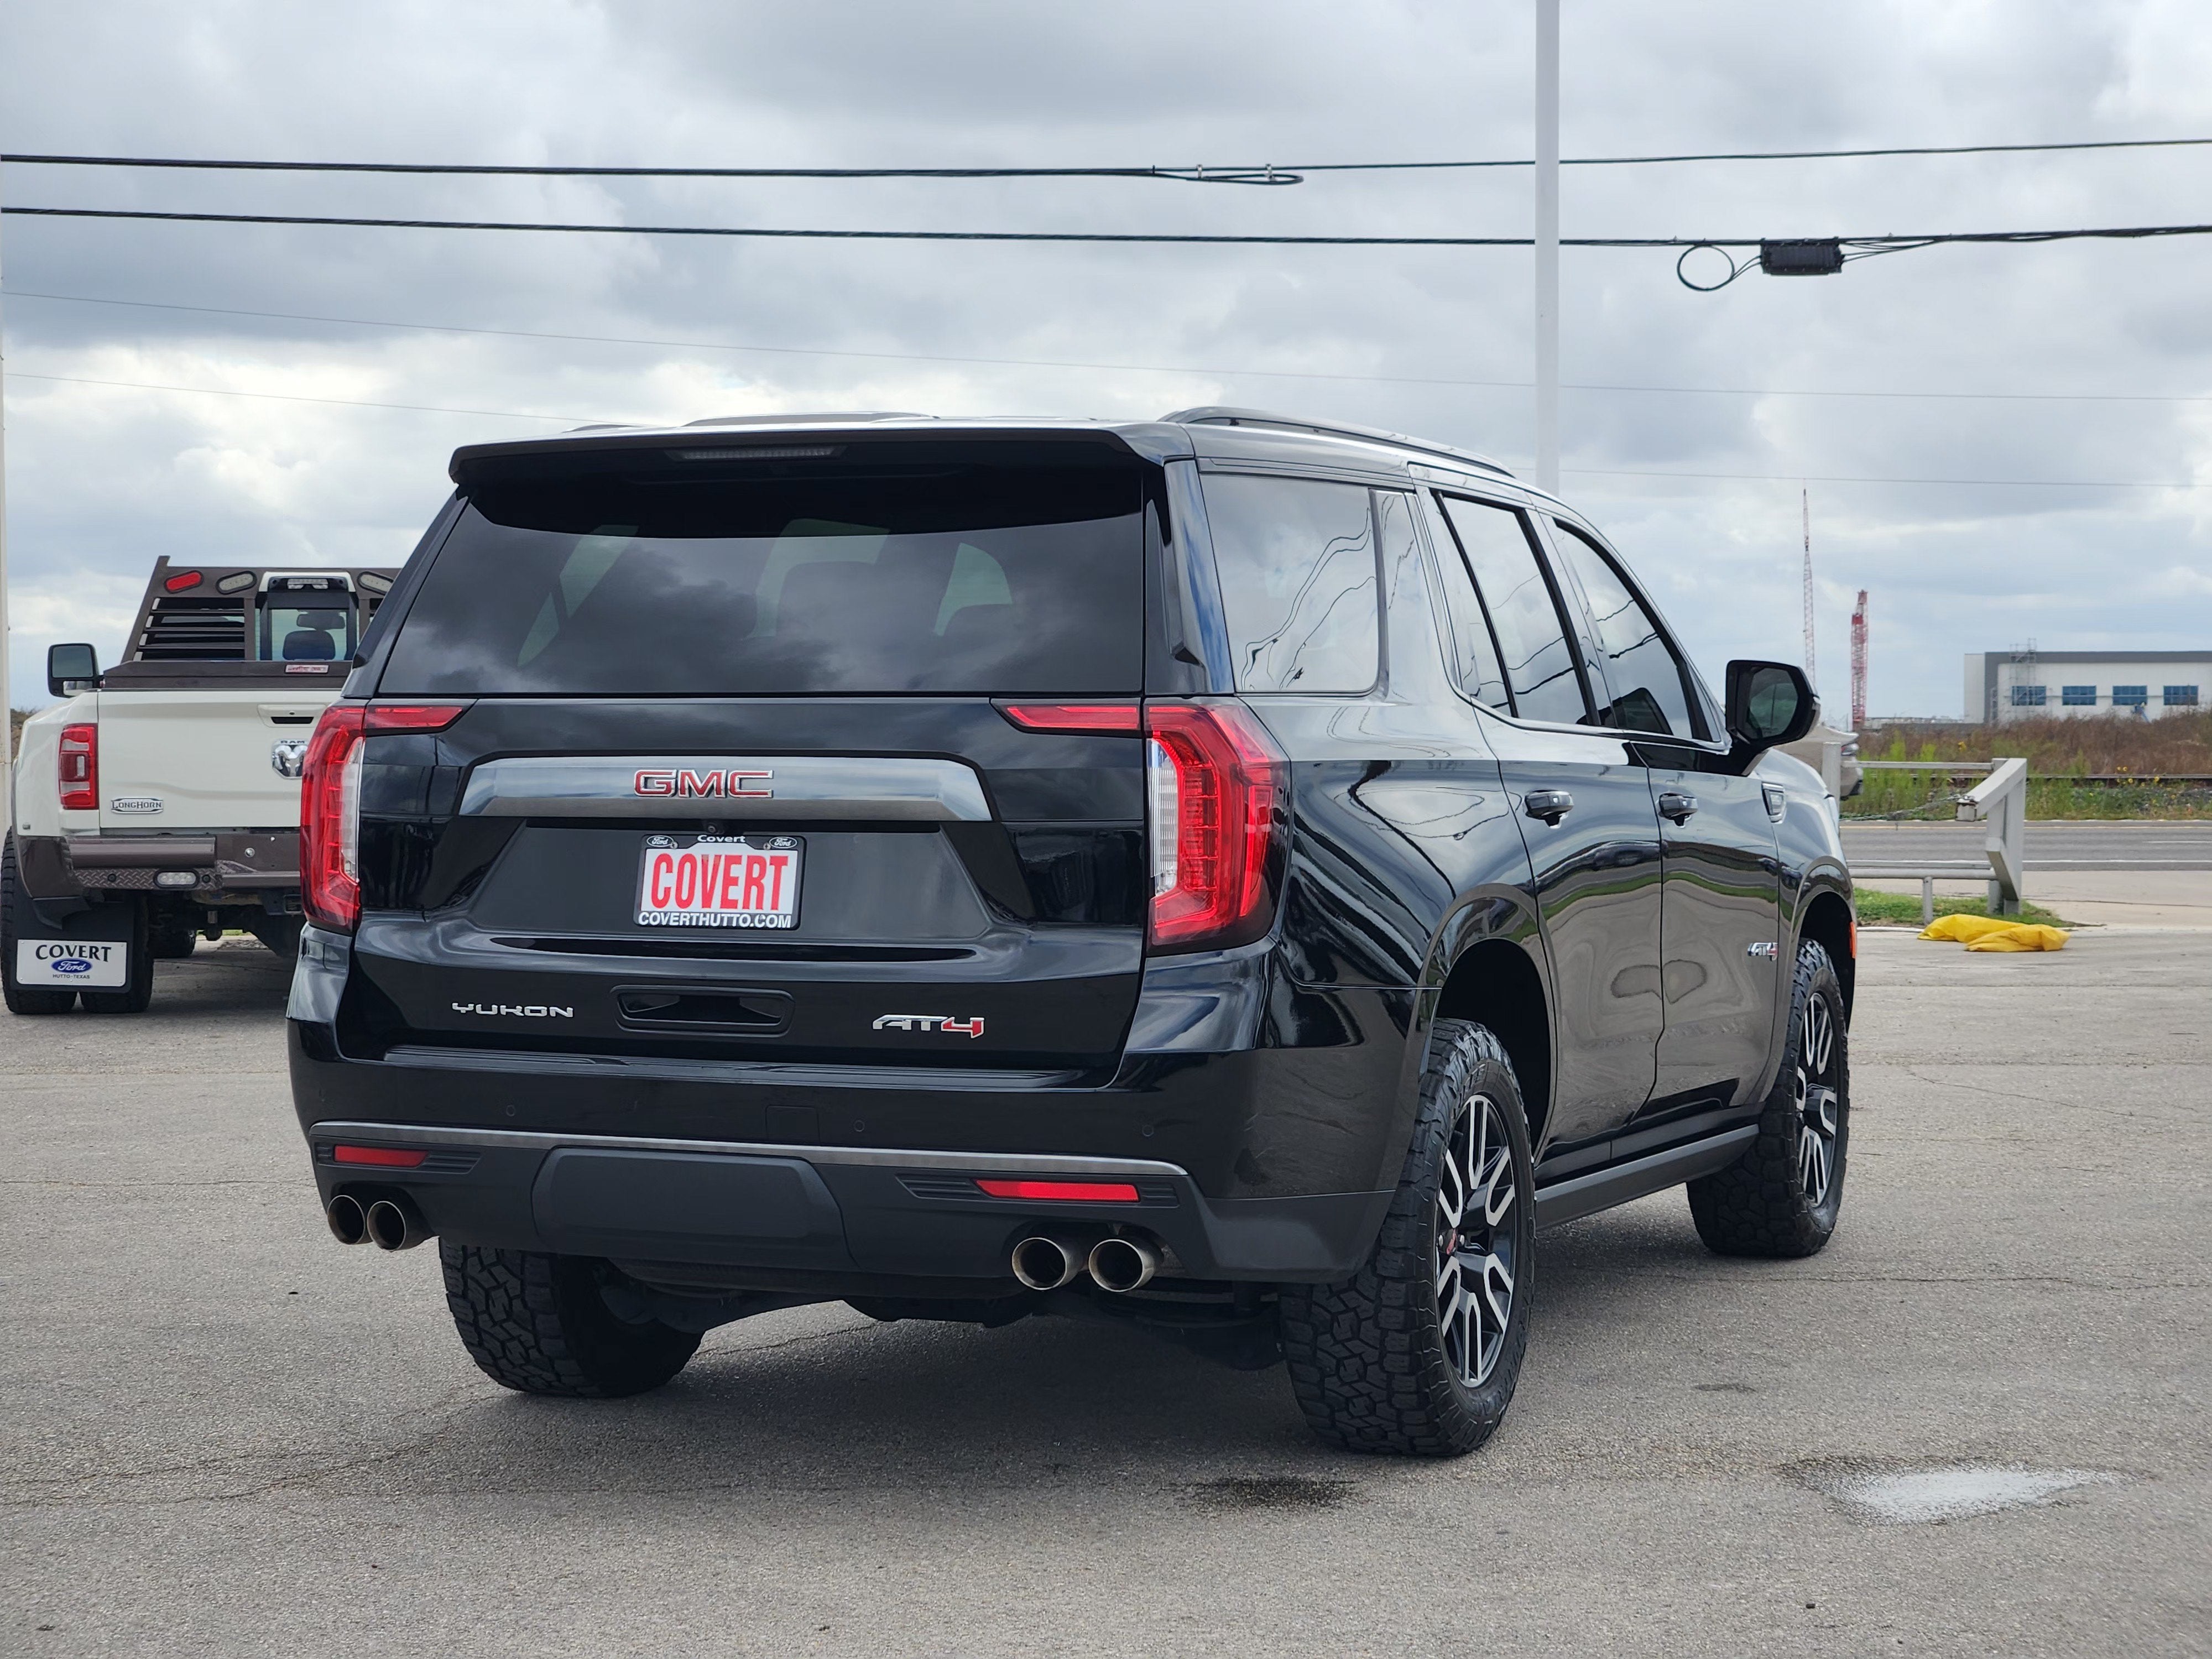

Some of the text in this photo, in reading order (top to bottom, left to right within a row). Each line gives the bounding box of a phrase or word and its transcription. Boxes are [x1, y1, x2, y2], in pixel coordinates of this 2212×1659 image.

[634, 769, 774, 798] GMC
[697, 834, 746, 843] Covert
[651, 853, 789, 911] COVERT
[638, 912, 792, 928] COVERTHUTTO.COM
[35, 944, 112, 962] COVERT
[58, 961, 86, 971] Ford
[452, 1003, 573, 1018] YUKON
[873, 1014, 985, 1039] AT4
